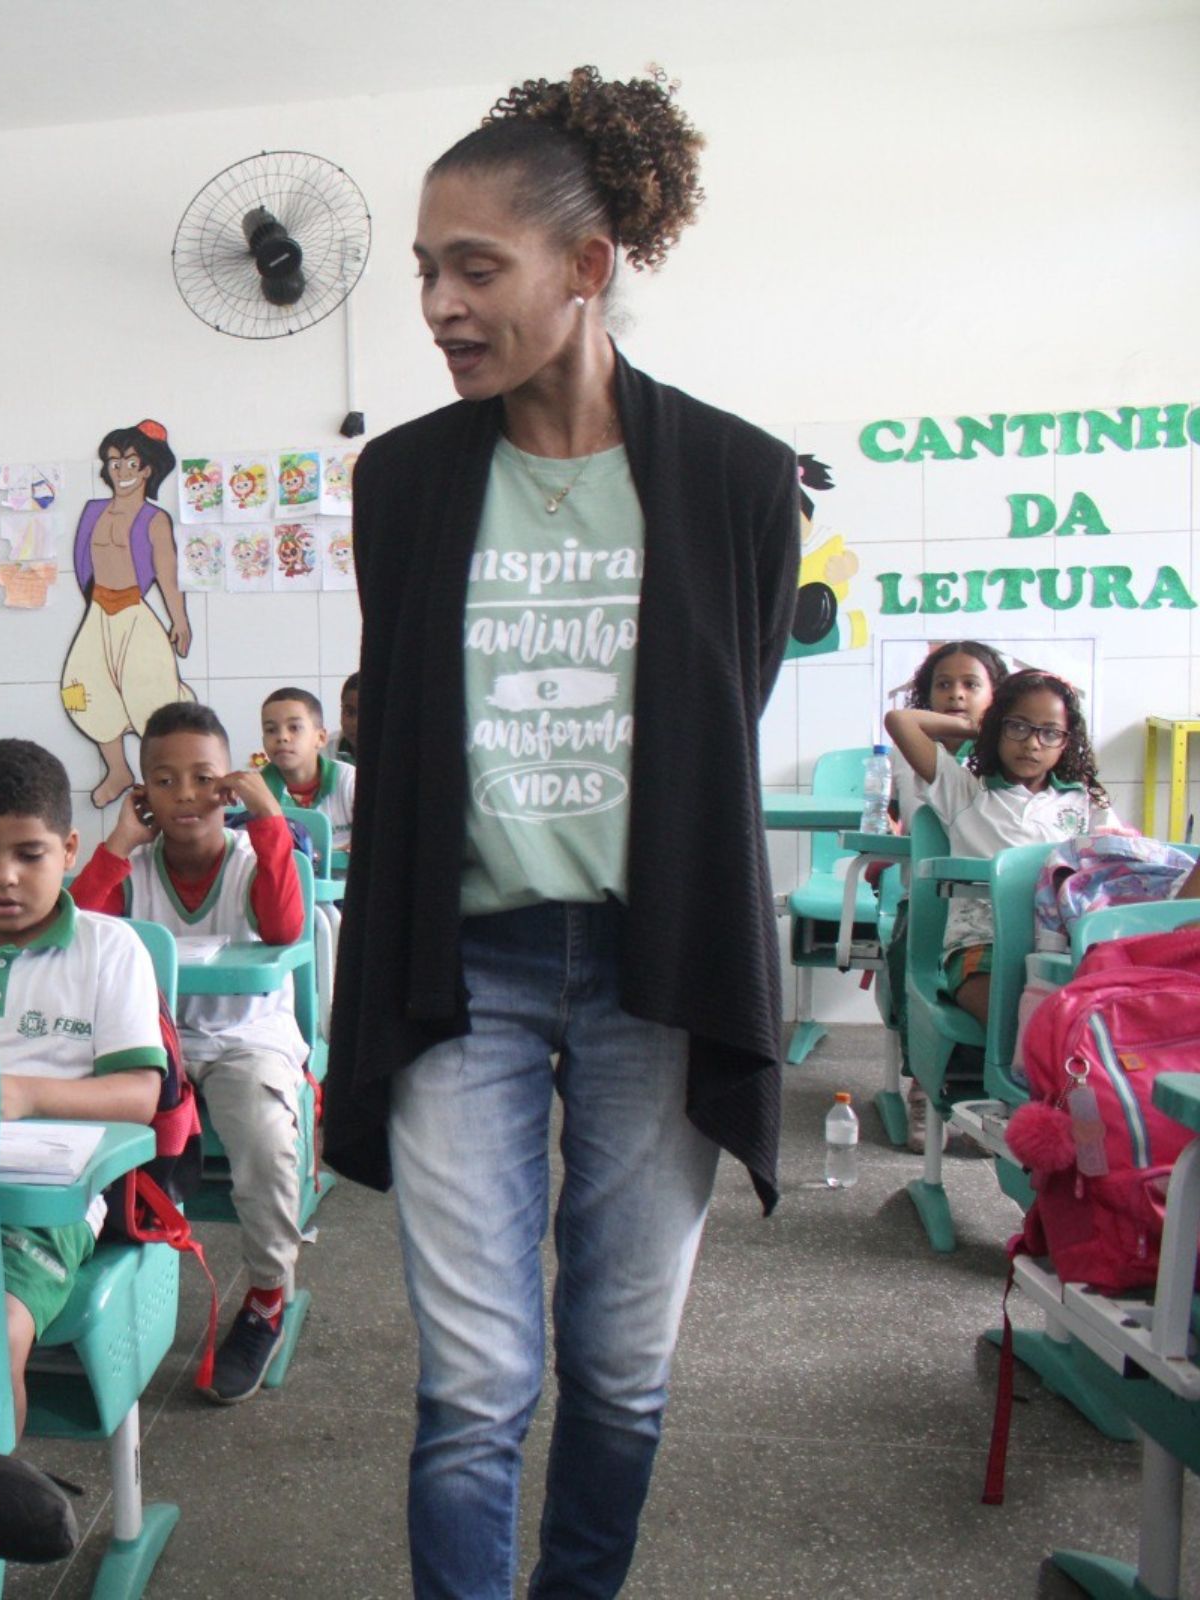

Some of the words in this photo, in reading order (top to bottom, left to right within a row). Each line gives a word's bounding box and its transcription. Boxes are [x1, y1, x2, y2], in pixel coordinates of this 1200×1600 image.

[1006, 491, 1111, 539] DA
[468, 537, 645, 595] nspira
[876, 566, 1198, 615] LEITURA
[465, 606, 639, 667] aminho
[536, 679, 560, 701] e
[468, 709, 634, 762] ansforma
[509, 772, 604, 807] VIDAS
